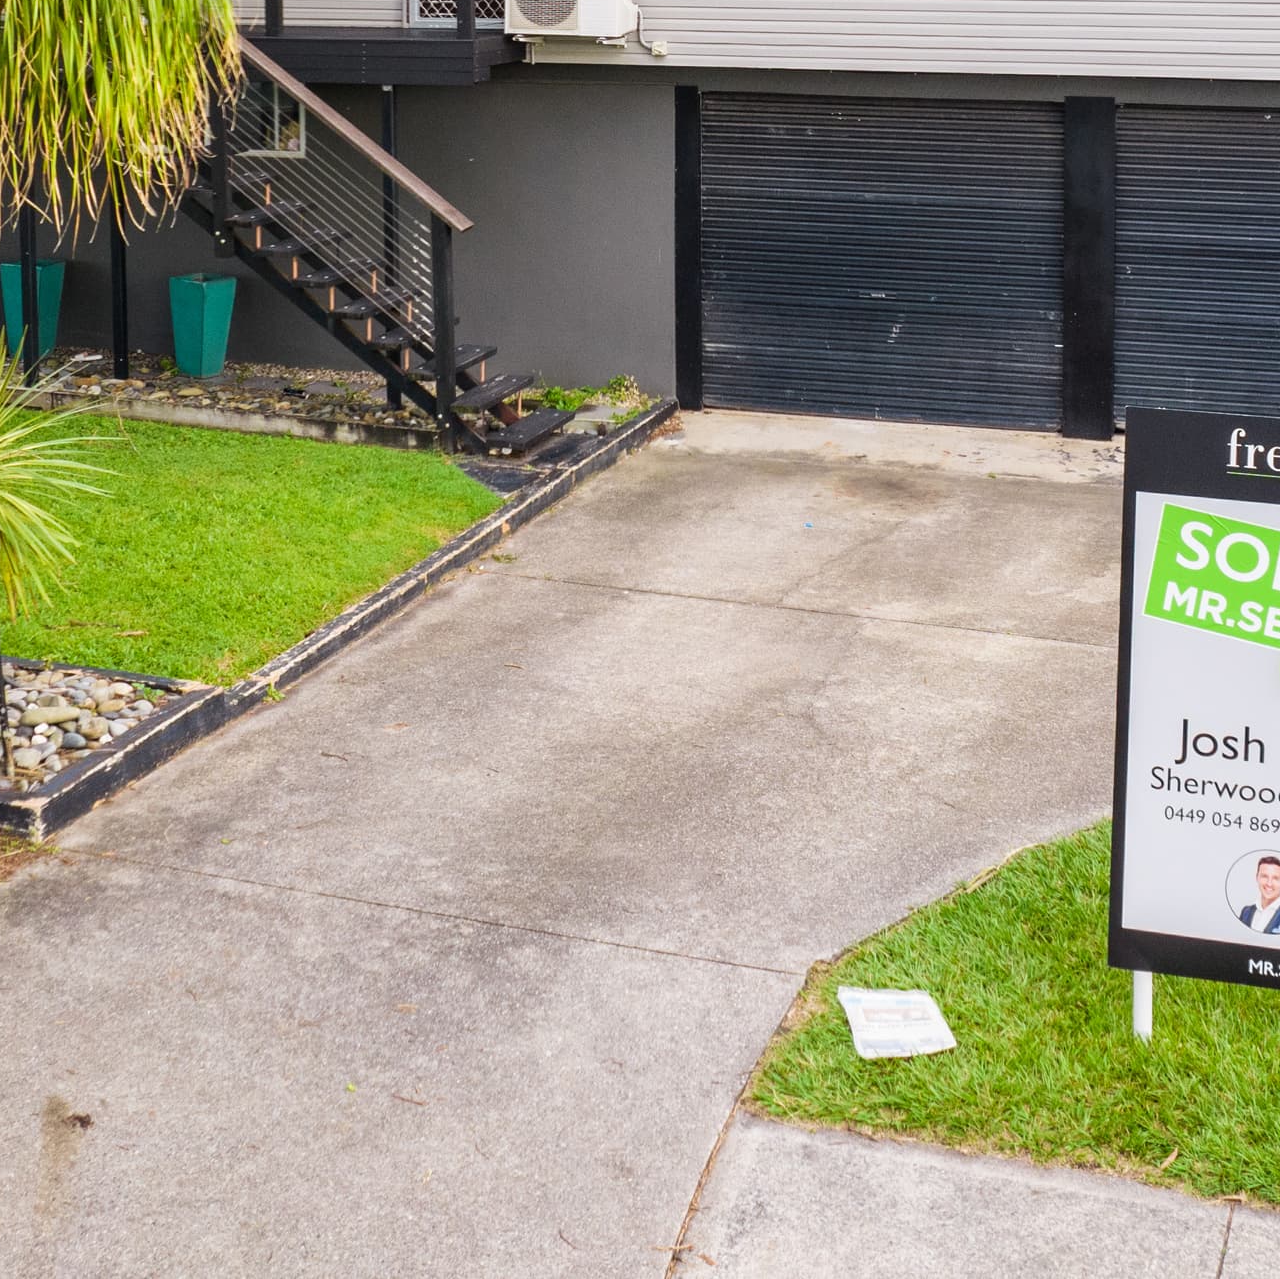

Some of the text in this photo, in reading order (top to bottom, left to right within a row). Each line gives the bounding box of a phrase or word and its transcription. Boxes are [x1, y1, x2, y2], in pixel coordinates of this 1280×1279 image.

[1174, 718, 1266, 765] Josh
[1164, 805, 1280, 834] 0449 054 869
